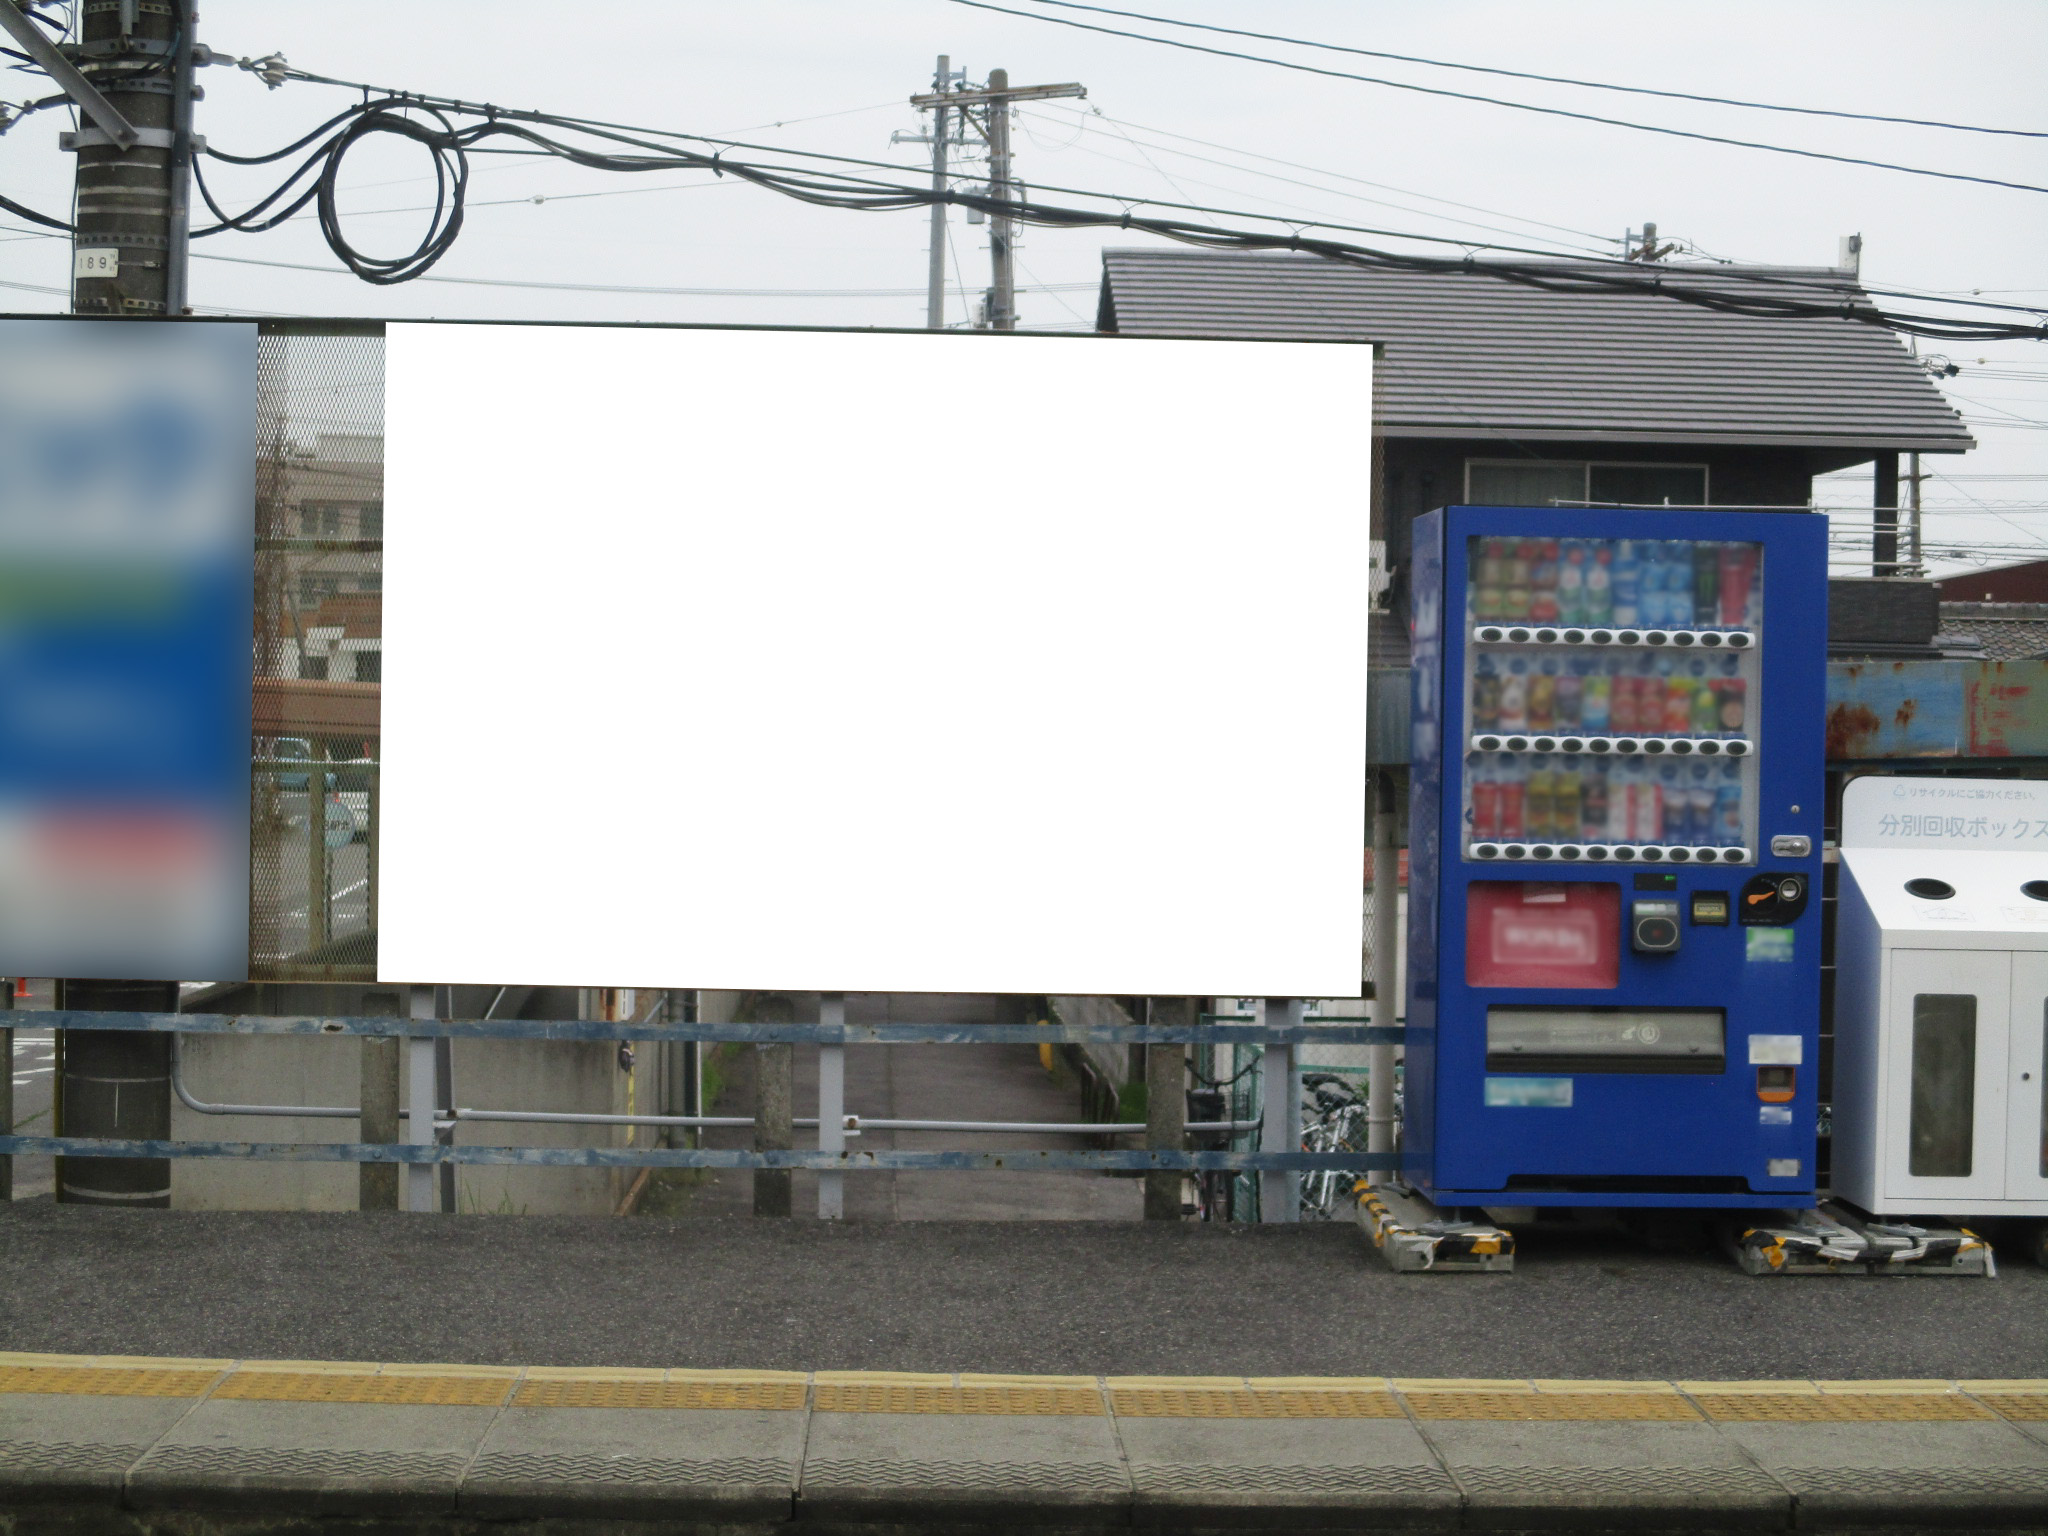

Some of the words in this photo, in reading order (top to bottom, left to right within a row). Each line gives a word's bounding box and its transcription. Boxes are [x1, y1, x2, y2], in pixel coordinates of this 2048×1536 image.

[1878, 813, 2048, 840] 分別回収ボックス
